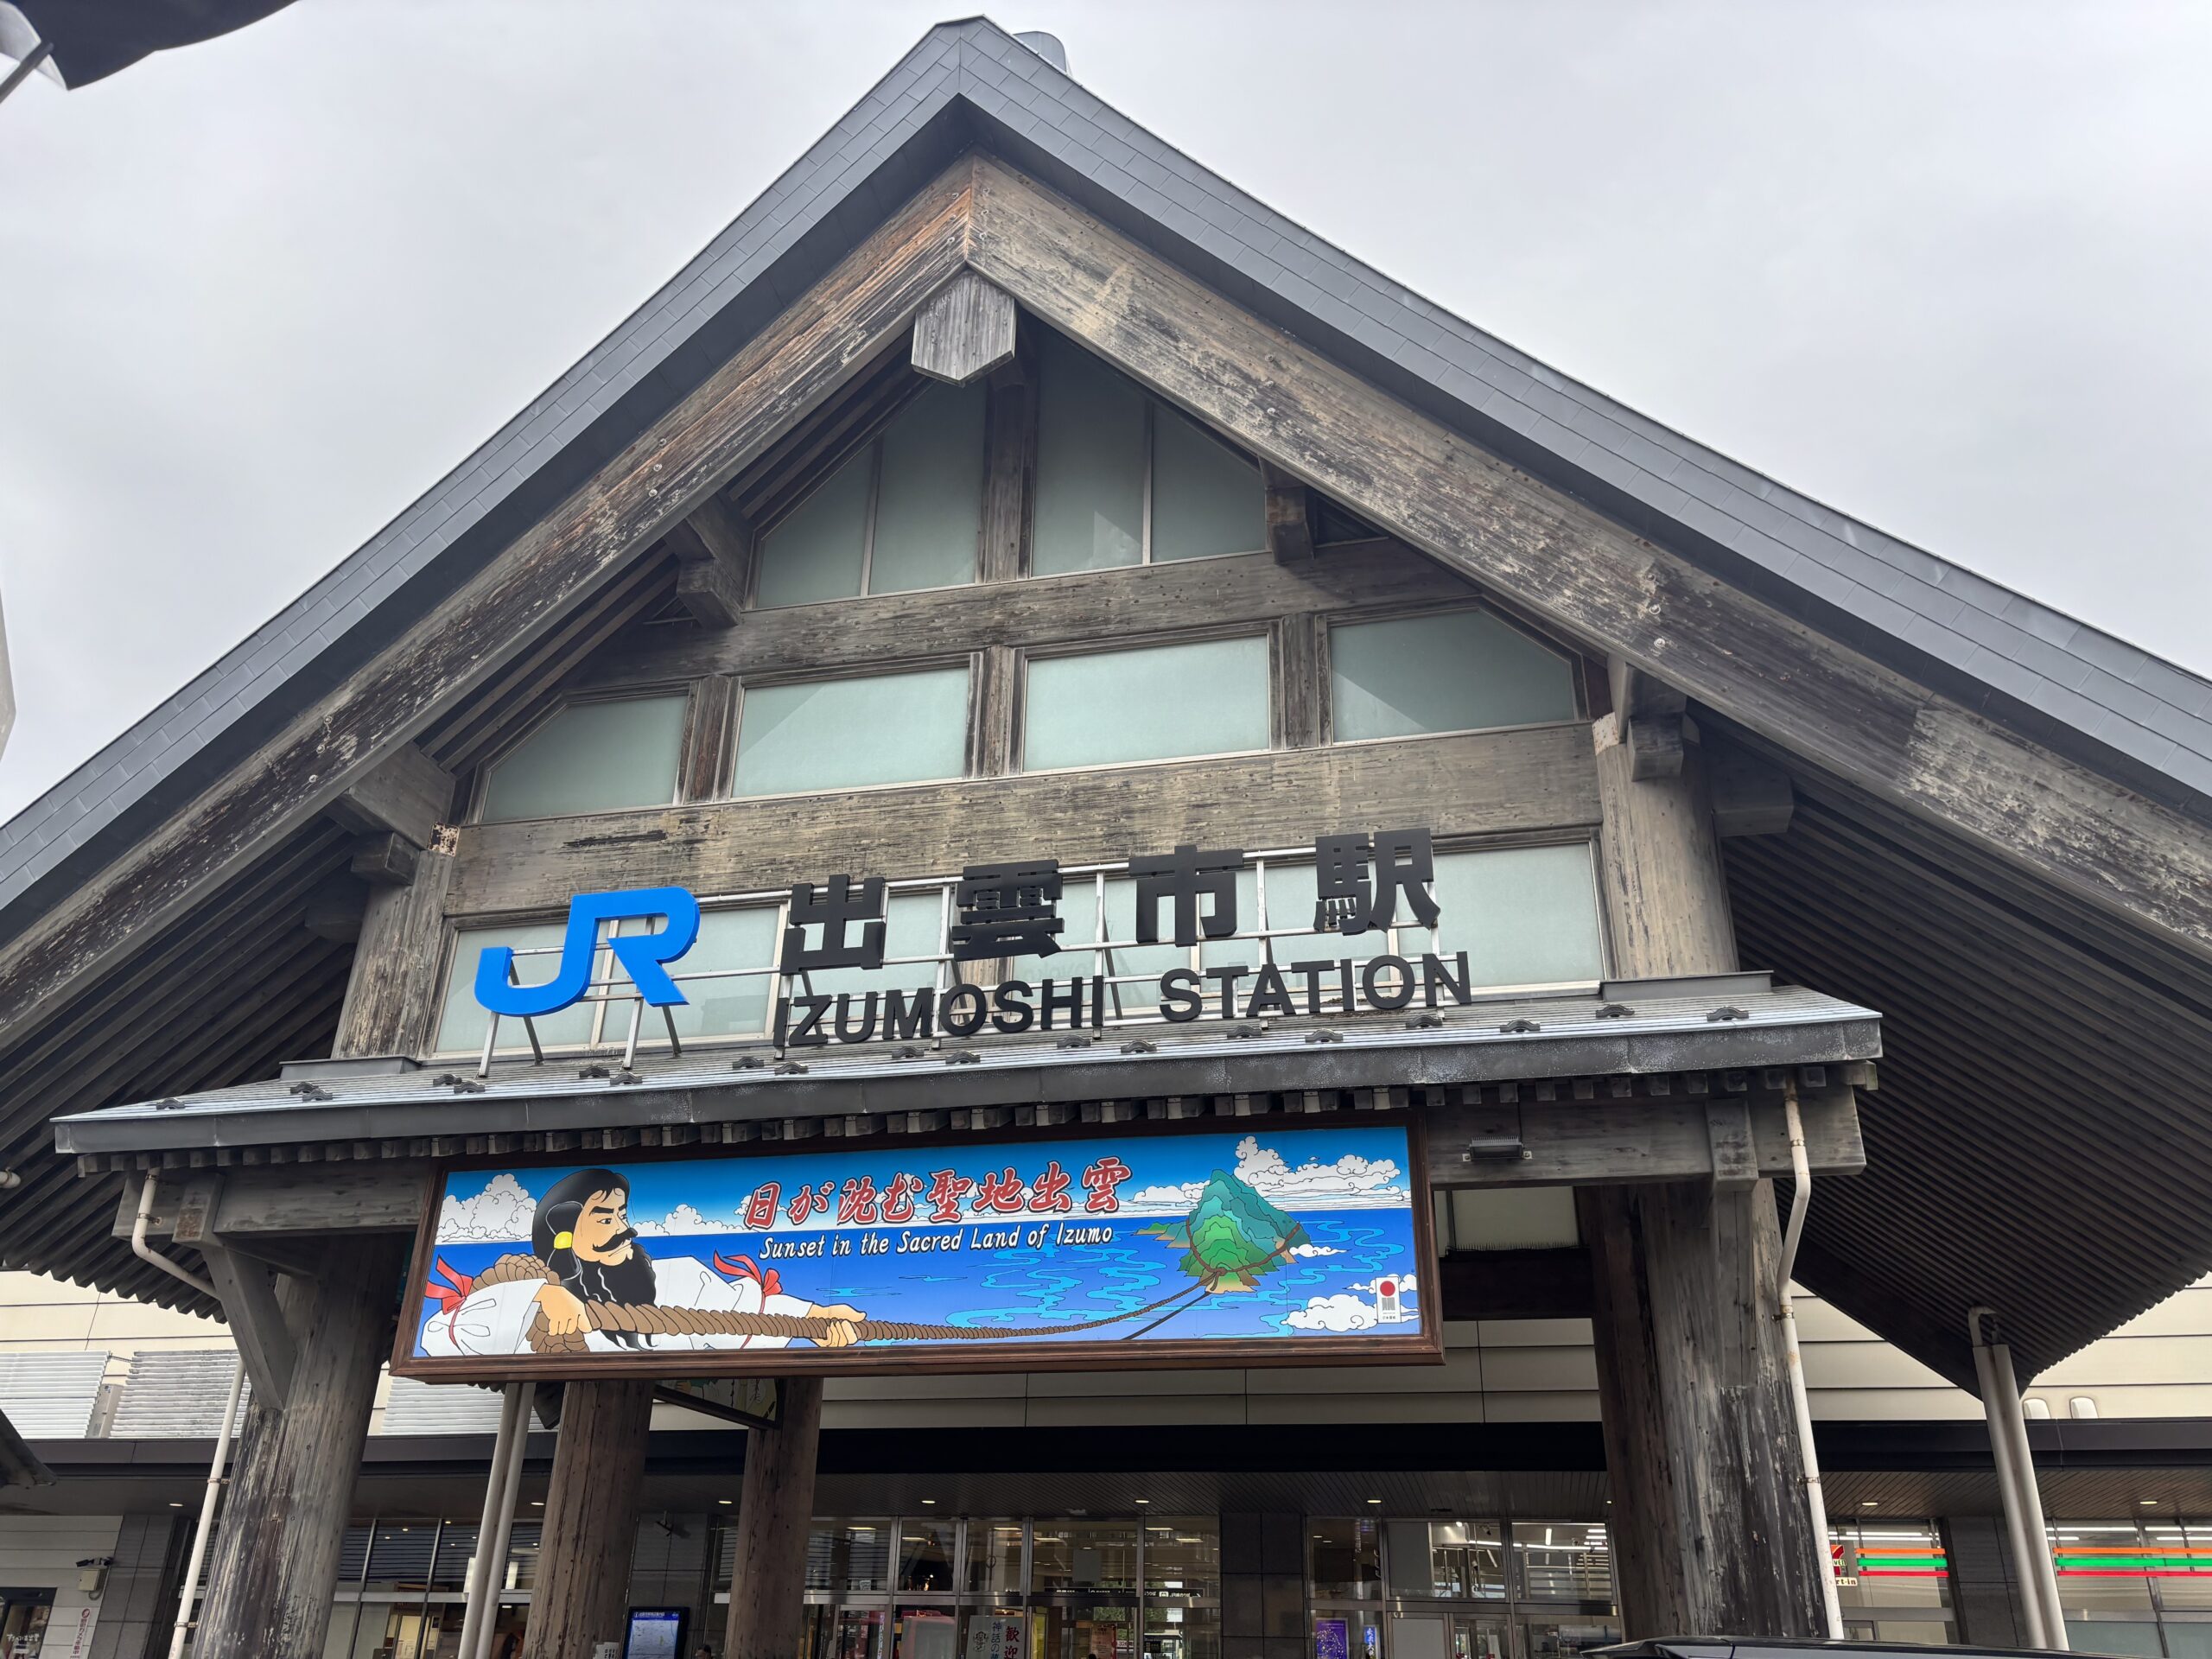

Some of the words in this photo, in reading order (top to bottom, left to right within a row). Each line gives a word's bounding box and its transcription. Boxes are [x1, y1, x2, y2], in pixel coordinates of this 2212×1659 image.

[779, 827, 1441, 976] 出雲市駅
[474, 886, 701, 1018] JR
[772, 974, 1105, 1049] IZUMOSHI
[1159, 950, 1471, 1023] STATION
[742, 1155, 1133, 1230] 日が沈む聖地出雲
[759, 1233, 825, 1261] Sunset
[832, 1235, 852, 1256] in
[860, 1230, 889, 1255] the
[896, 1226, 963, 1254] Sacred
[969, 1224, 1019, 1250] Land
[1026, 1223, 1048, 1247] of
[1056, 1221, 1114, 1245] Izumo
